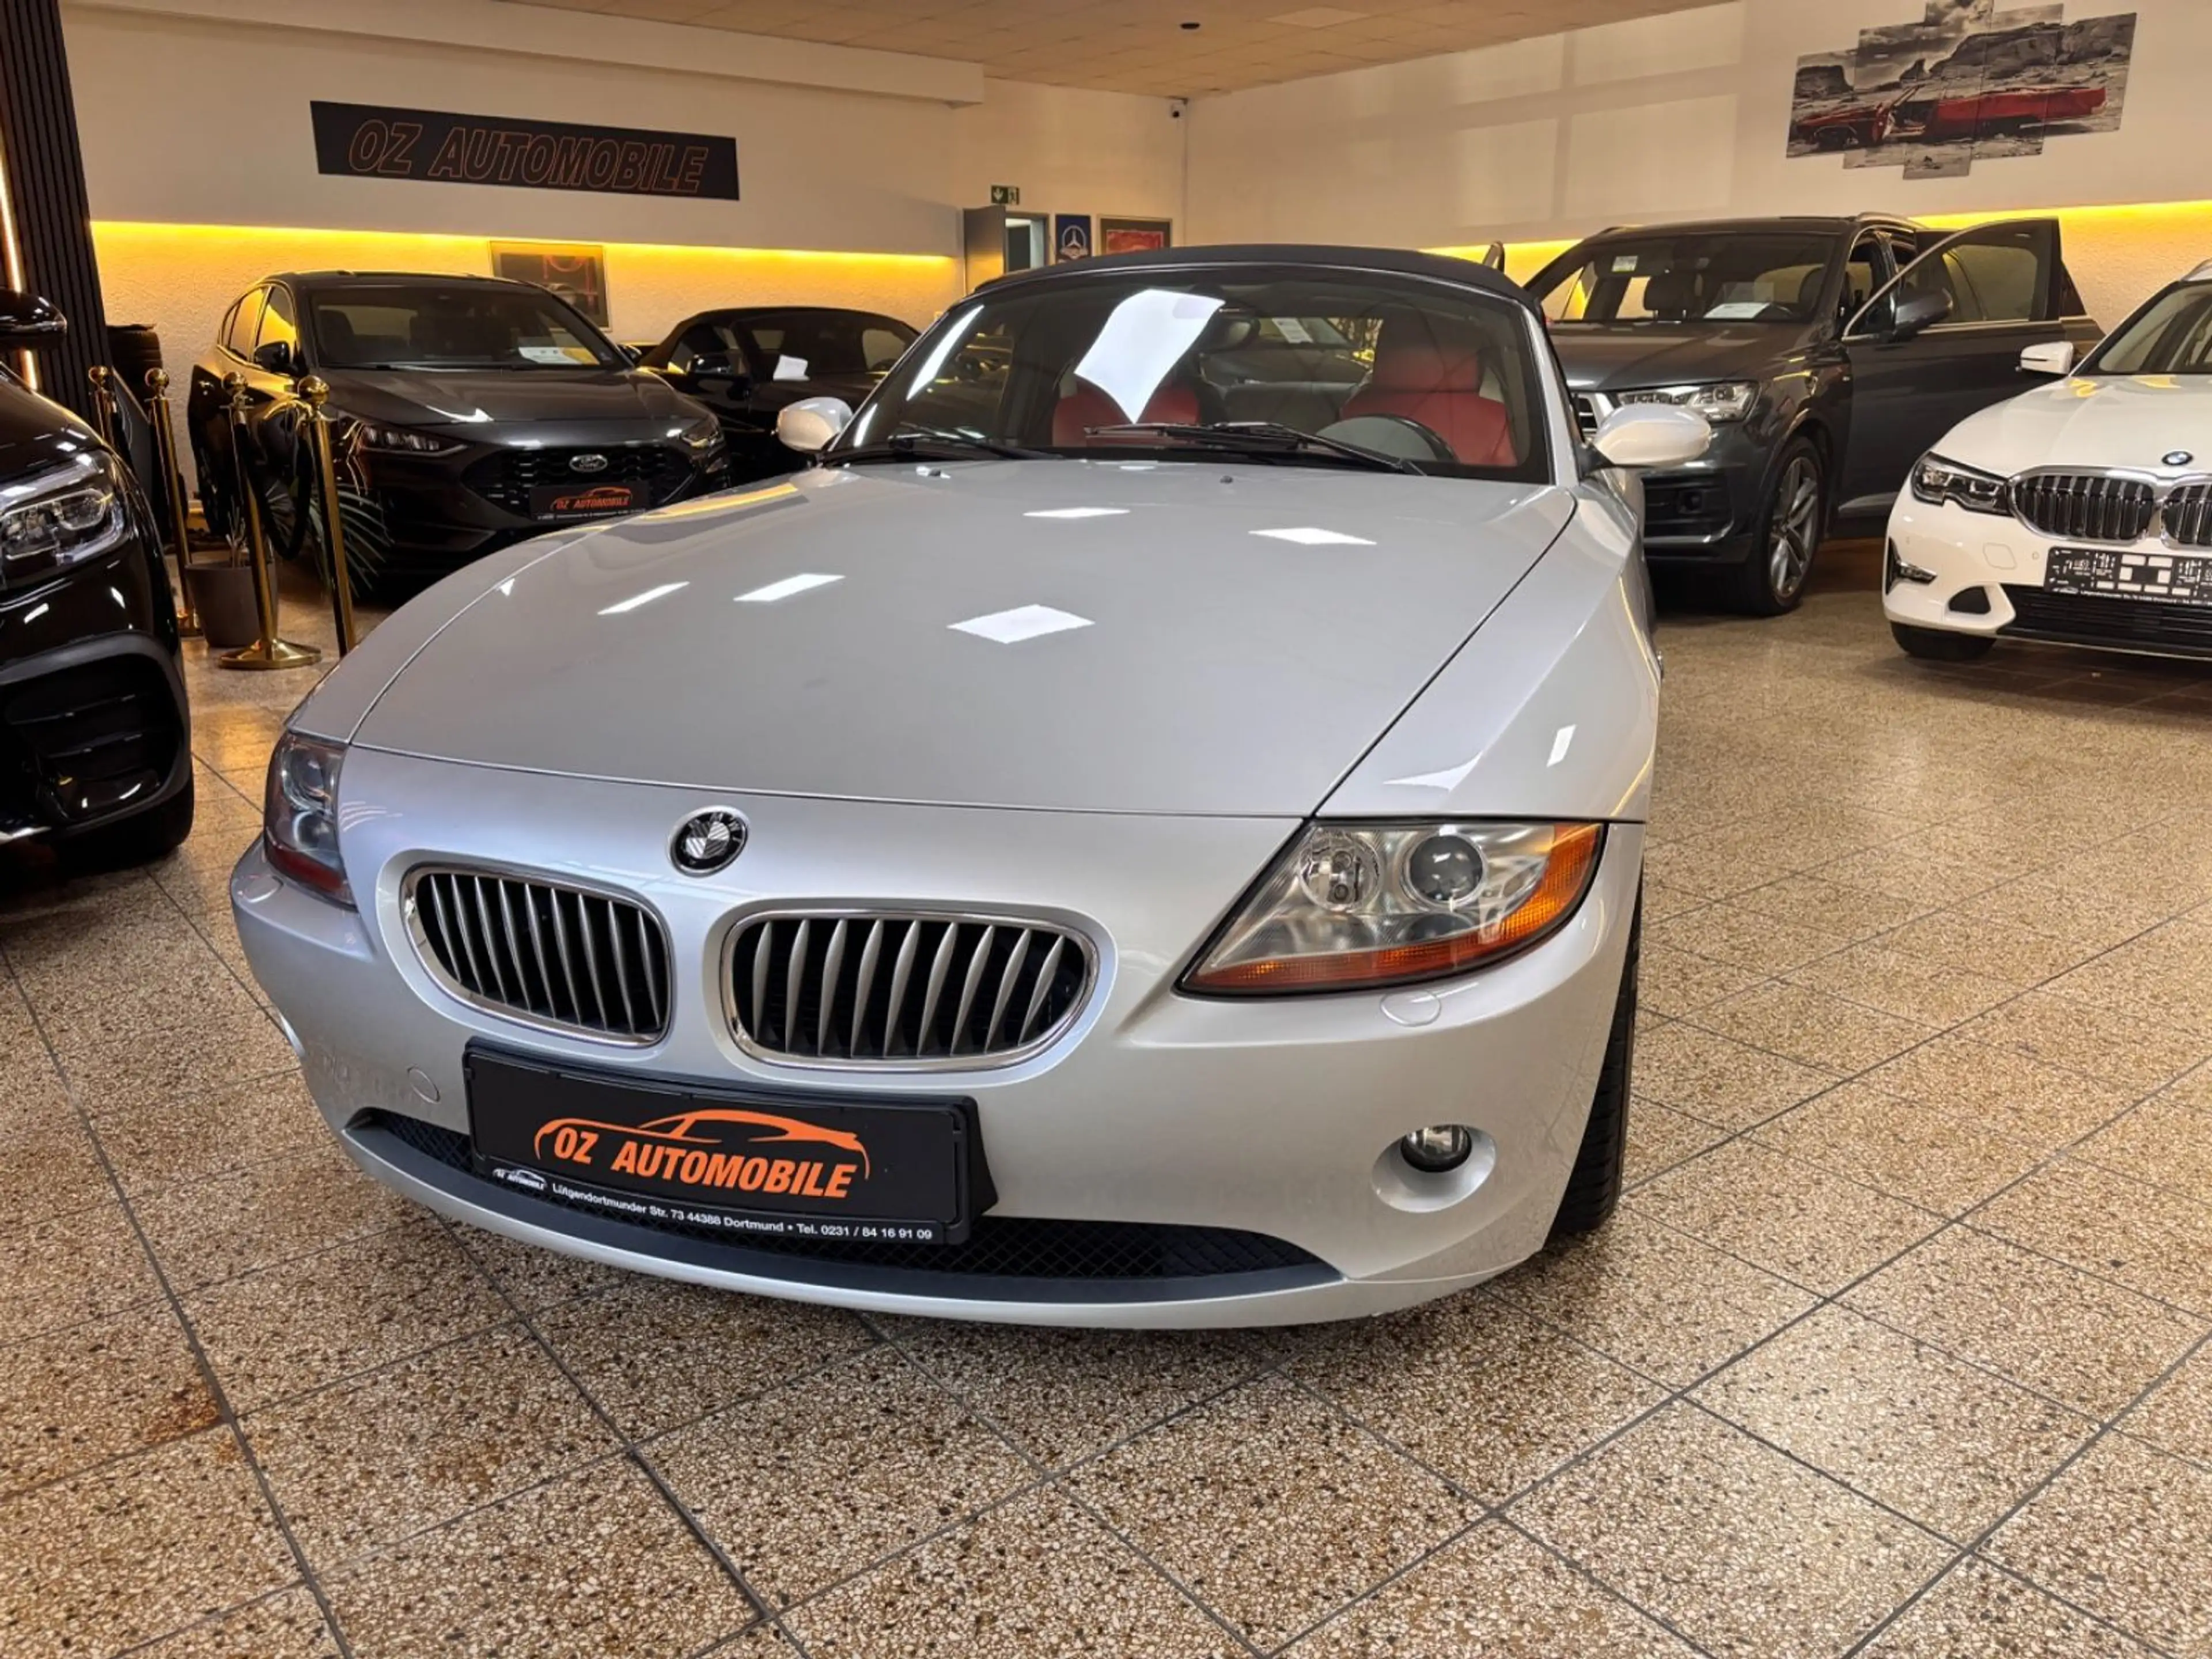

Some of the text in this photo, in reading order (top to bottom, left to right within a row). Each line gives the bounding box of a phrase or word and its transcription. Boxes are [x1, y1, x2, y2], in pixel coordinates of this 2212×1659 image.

[349, 119, 709, 194] OZ AUTOMOBILE
[553, 1128, 857, 1199] OZ AUTOMOBILE
[670, 1209, 685, 1221] 73
[687, 1212, 721, 1225] 44388
[723, 1216, 784, 1232] Dortmund
[796, 1223, 818, 1234] Tel.
[820, 1225, 849, 1236] 0231
[862, 1227, 877, 1237] 84
[881, 1228, 896, 1238] 16
[898, 1228, 912, 1238] 91
[916, 1229, 933, 1240] 09
